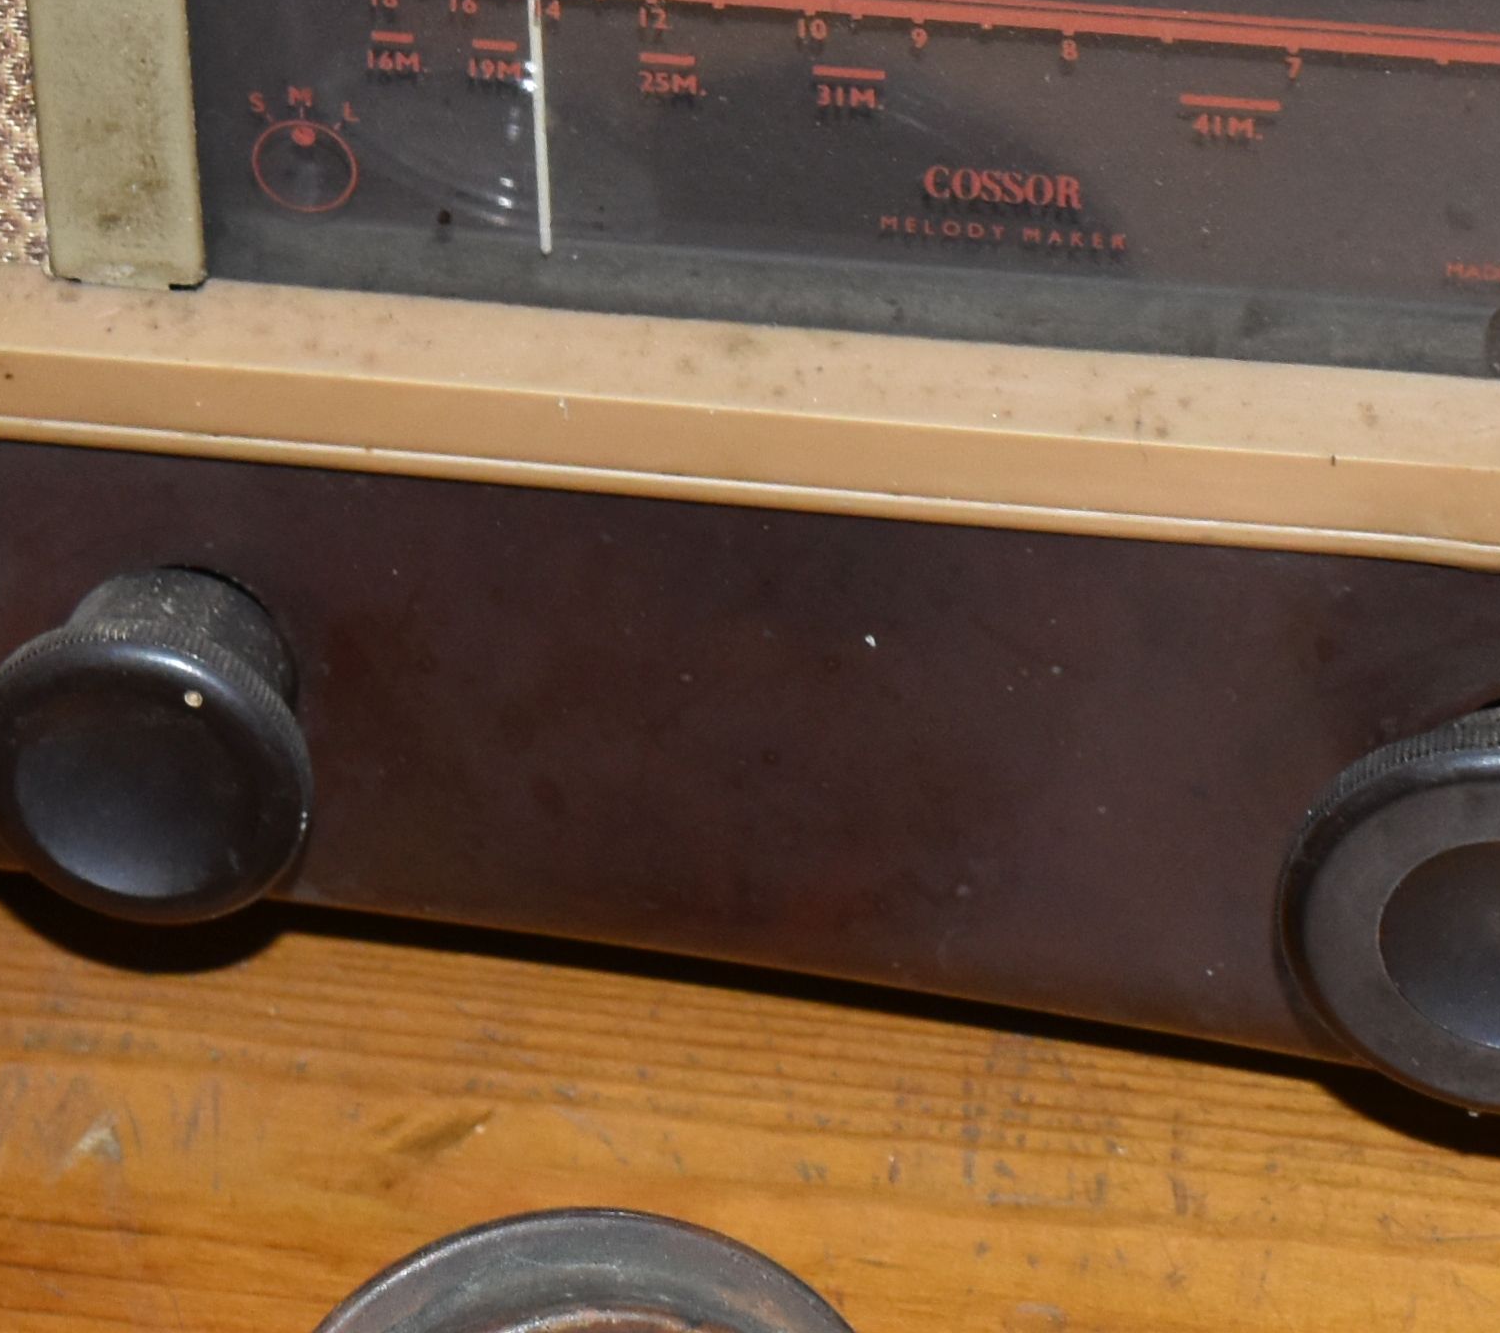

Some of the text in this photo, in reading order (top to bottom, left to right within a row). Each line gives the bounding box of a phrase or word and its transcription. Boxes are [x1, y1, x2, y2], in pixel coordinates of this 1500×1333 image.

[638, 7, 669, 30] 12
[797, 18, 827, 41] 10
[911, 29, 928, 49] 9
[1062, 40, 1078, 62] 8
[1285, 56, 1301, 80] 7
[289, 87, 312, 107] M
[924, 165, 1082, 210] COSSOR
[881, 215, 1126, 251] MELODY MAKER
